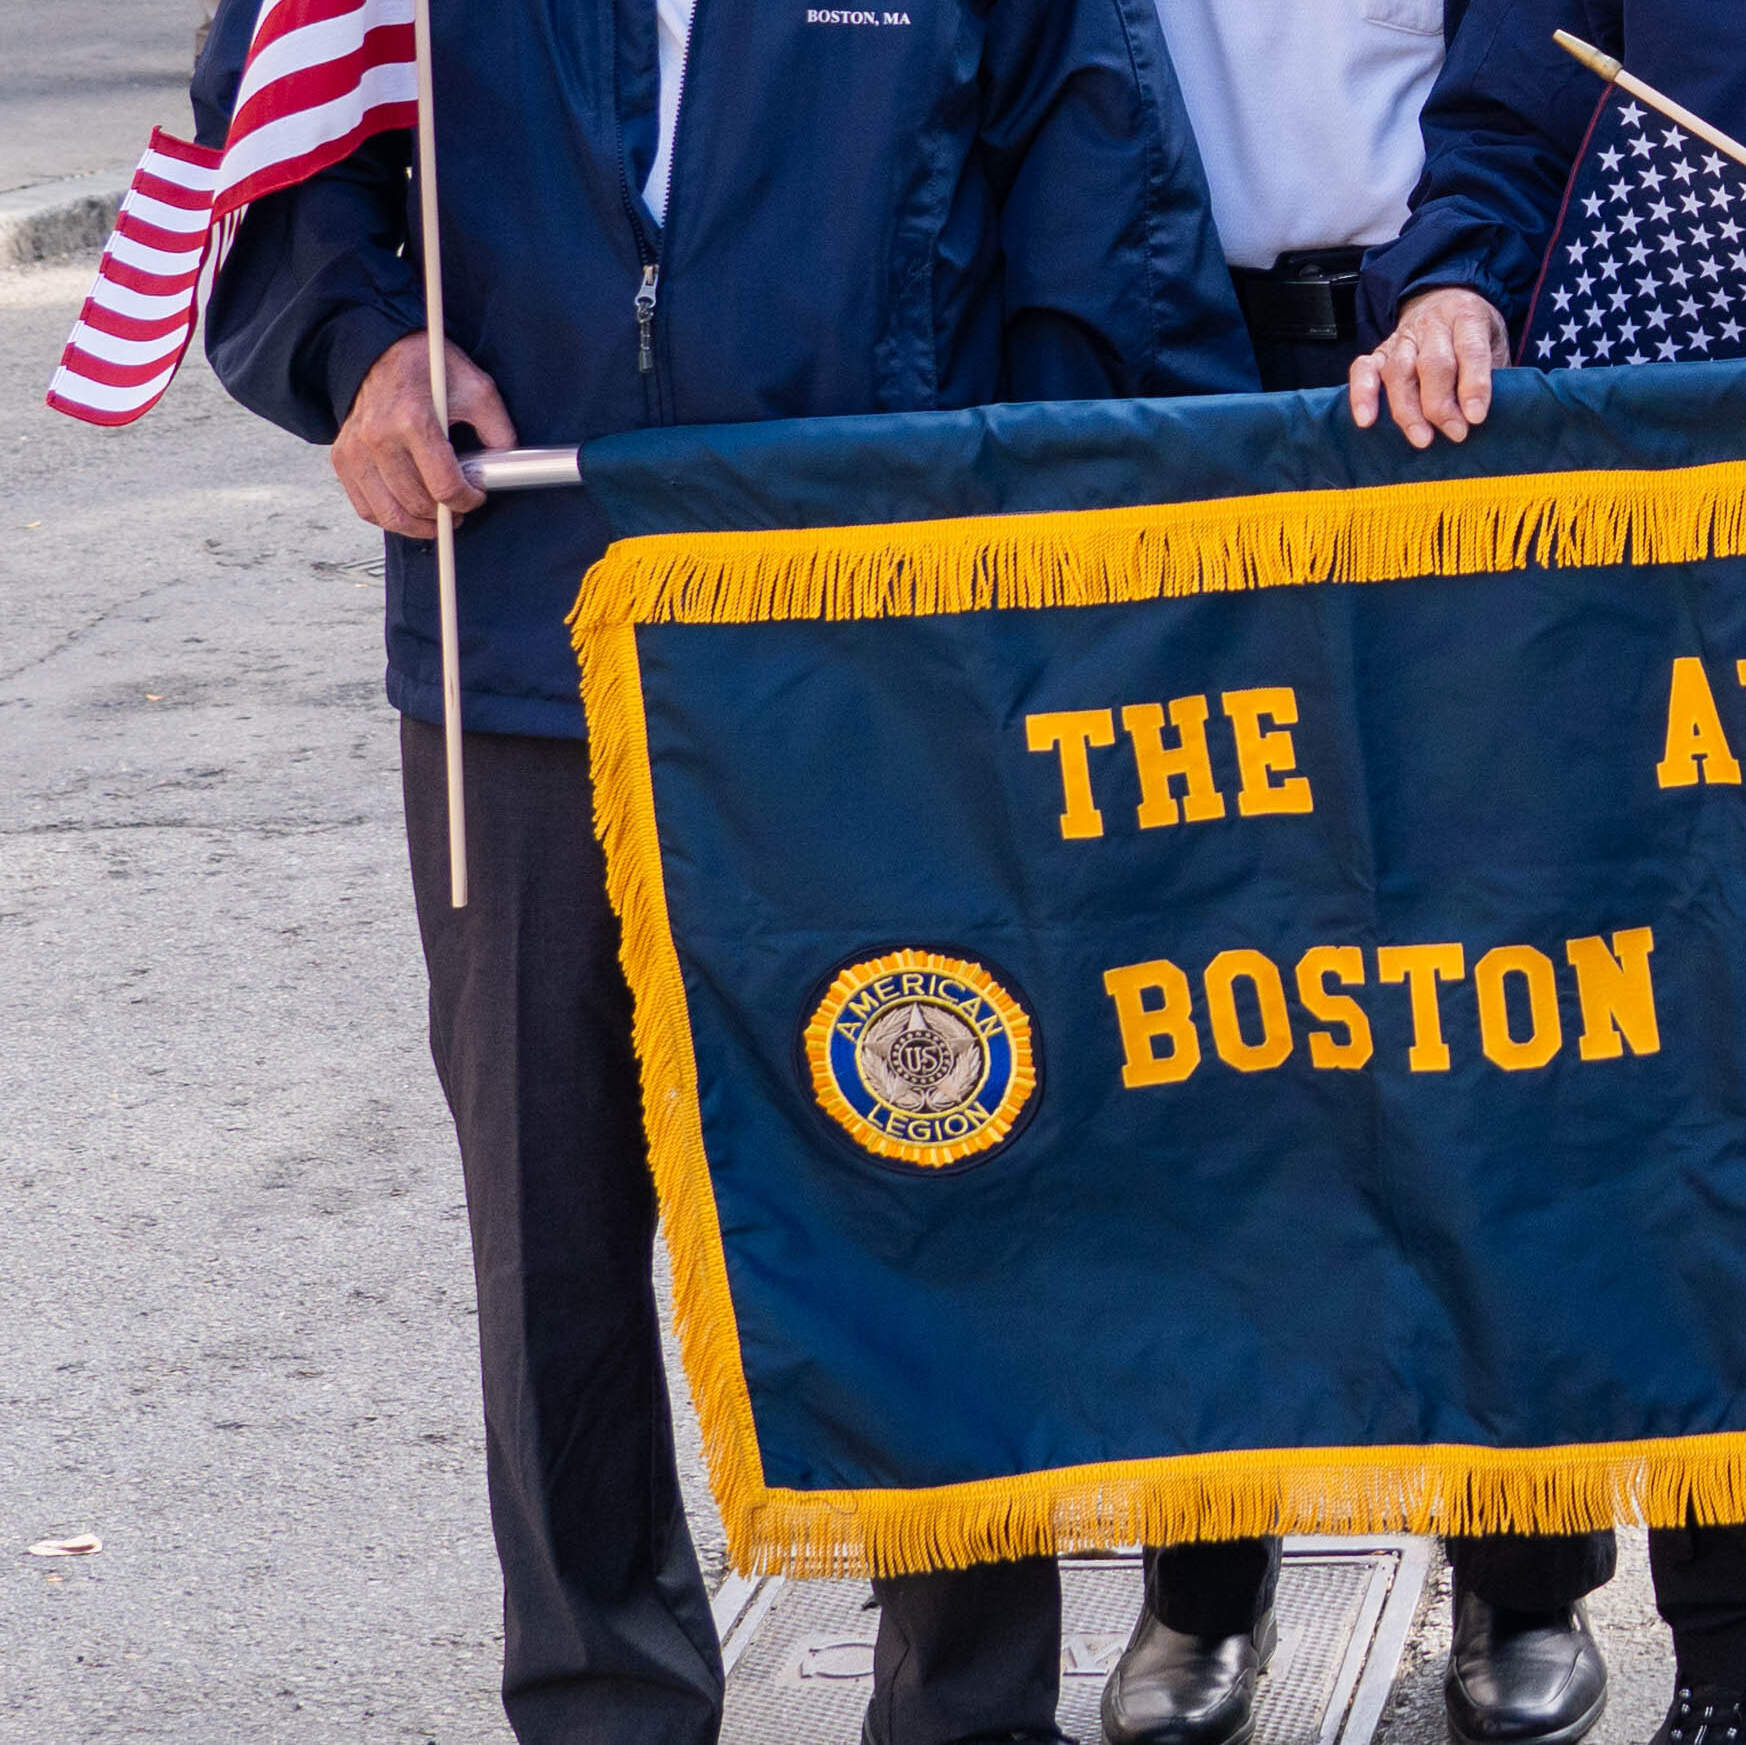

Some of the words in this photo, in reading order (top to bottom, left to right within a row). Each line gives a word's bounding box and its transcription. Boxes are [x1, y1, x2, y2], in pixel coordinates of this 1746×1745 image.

[806, 9, 880, 27] BOSTON,
[883, 12, 912, 27] MA
[1024, 686, 1316, 841] THE
[835, 973, 1004, 1045] AMERICAN
[1104, 926, 1662, 1088] BOSTON
[866, 1101, 990, 1142] LEGION
